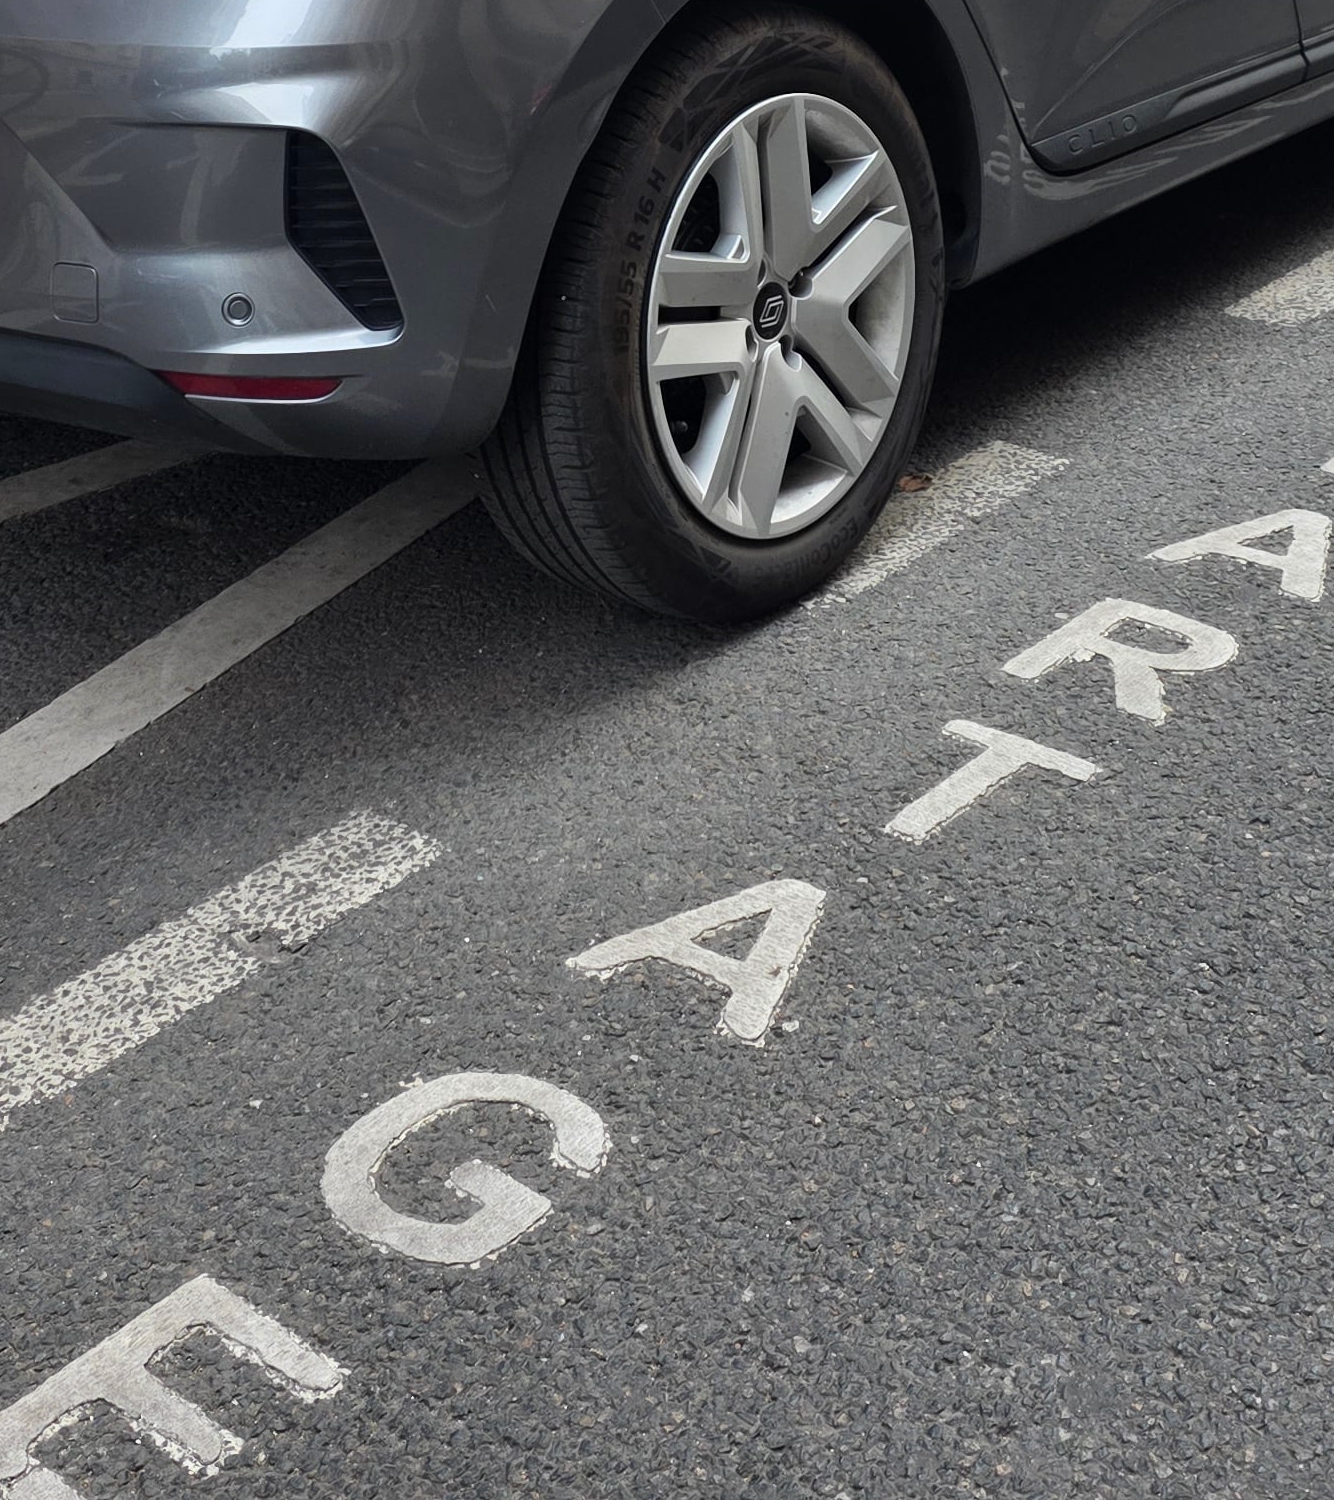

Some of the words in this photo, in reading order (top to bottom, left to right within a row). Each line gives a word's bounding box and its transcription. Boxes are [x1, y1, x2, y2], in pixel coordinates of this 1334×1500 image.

[1067, 114, 1138, 155] CLIO
[645, 165, 666, 193] H
[633, 194, 656, 226] 16
[624, 230, 647, 253] R
[611, 259, 640, 357] 195/55
